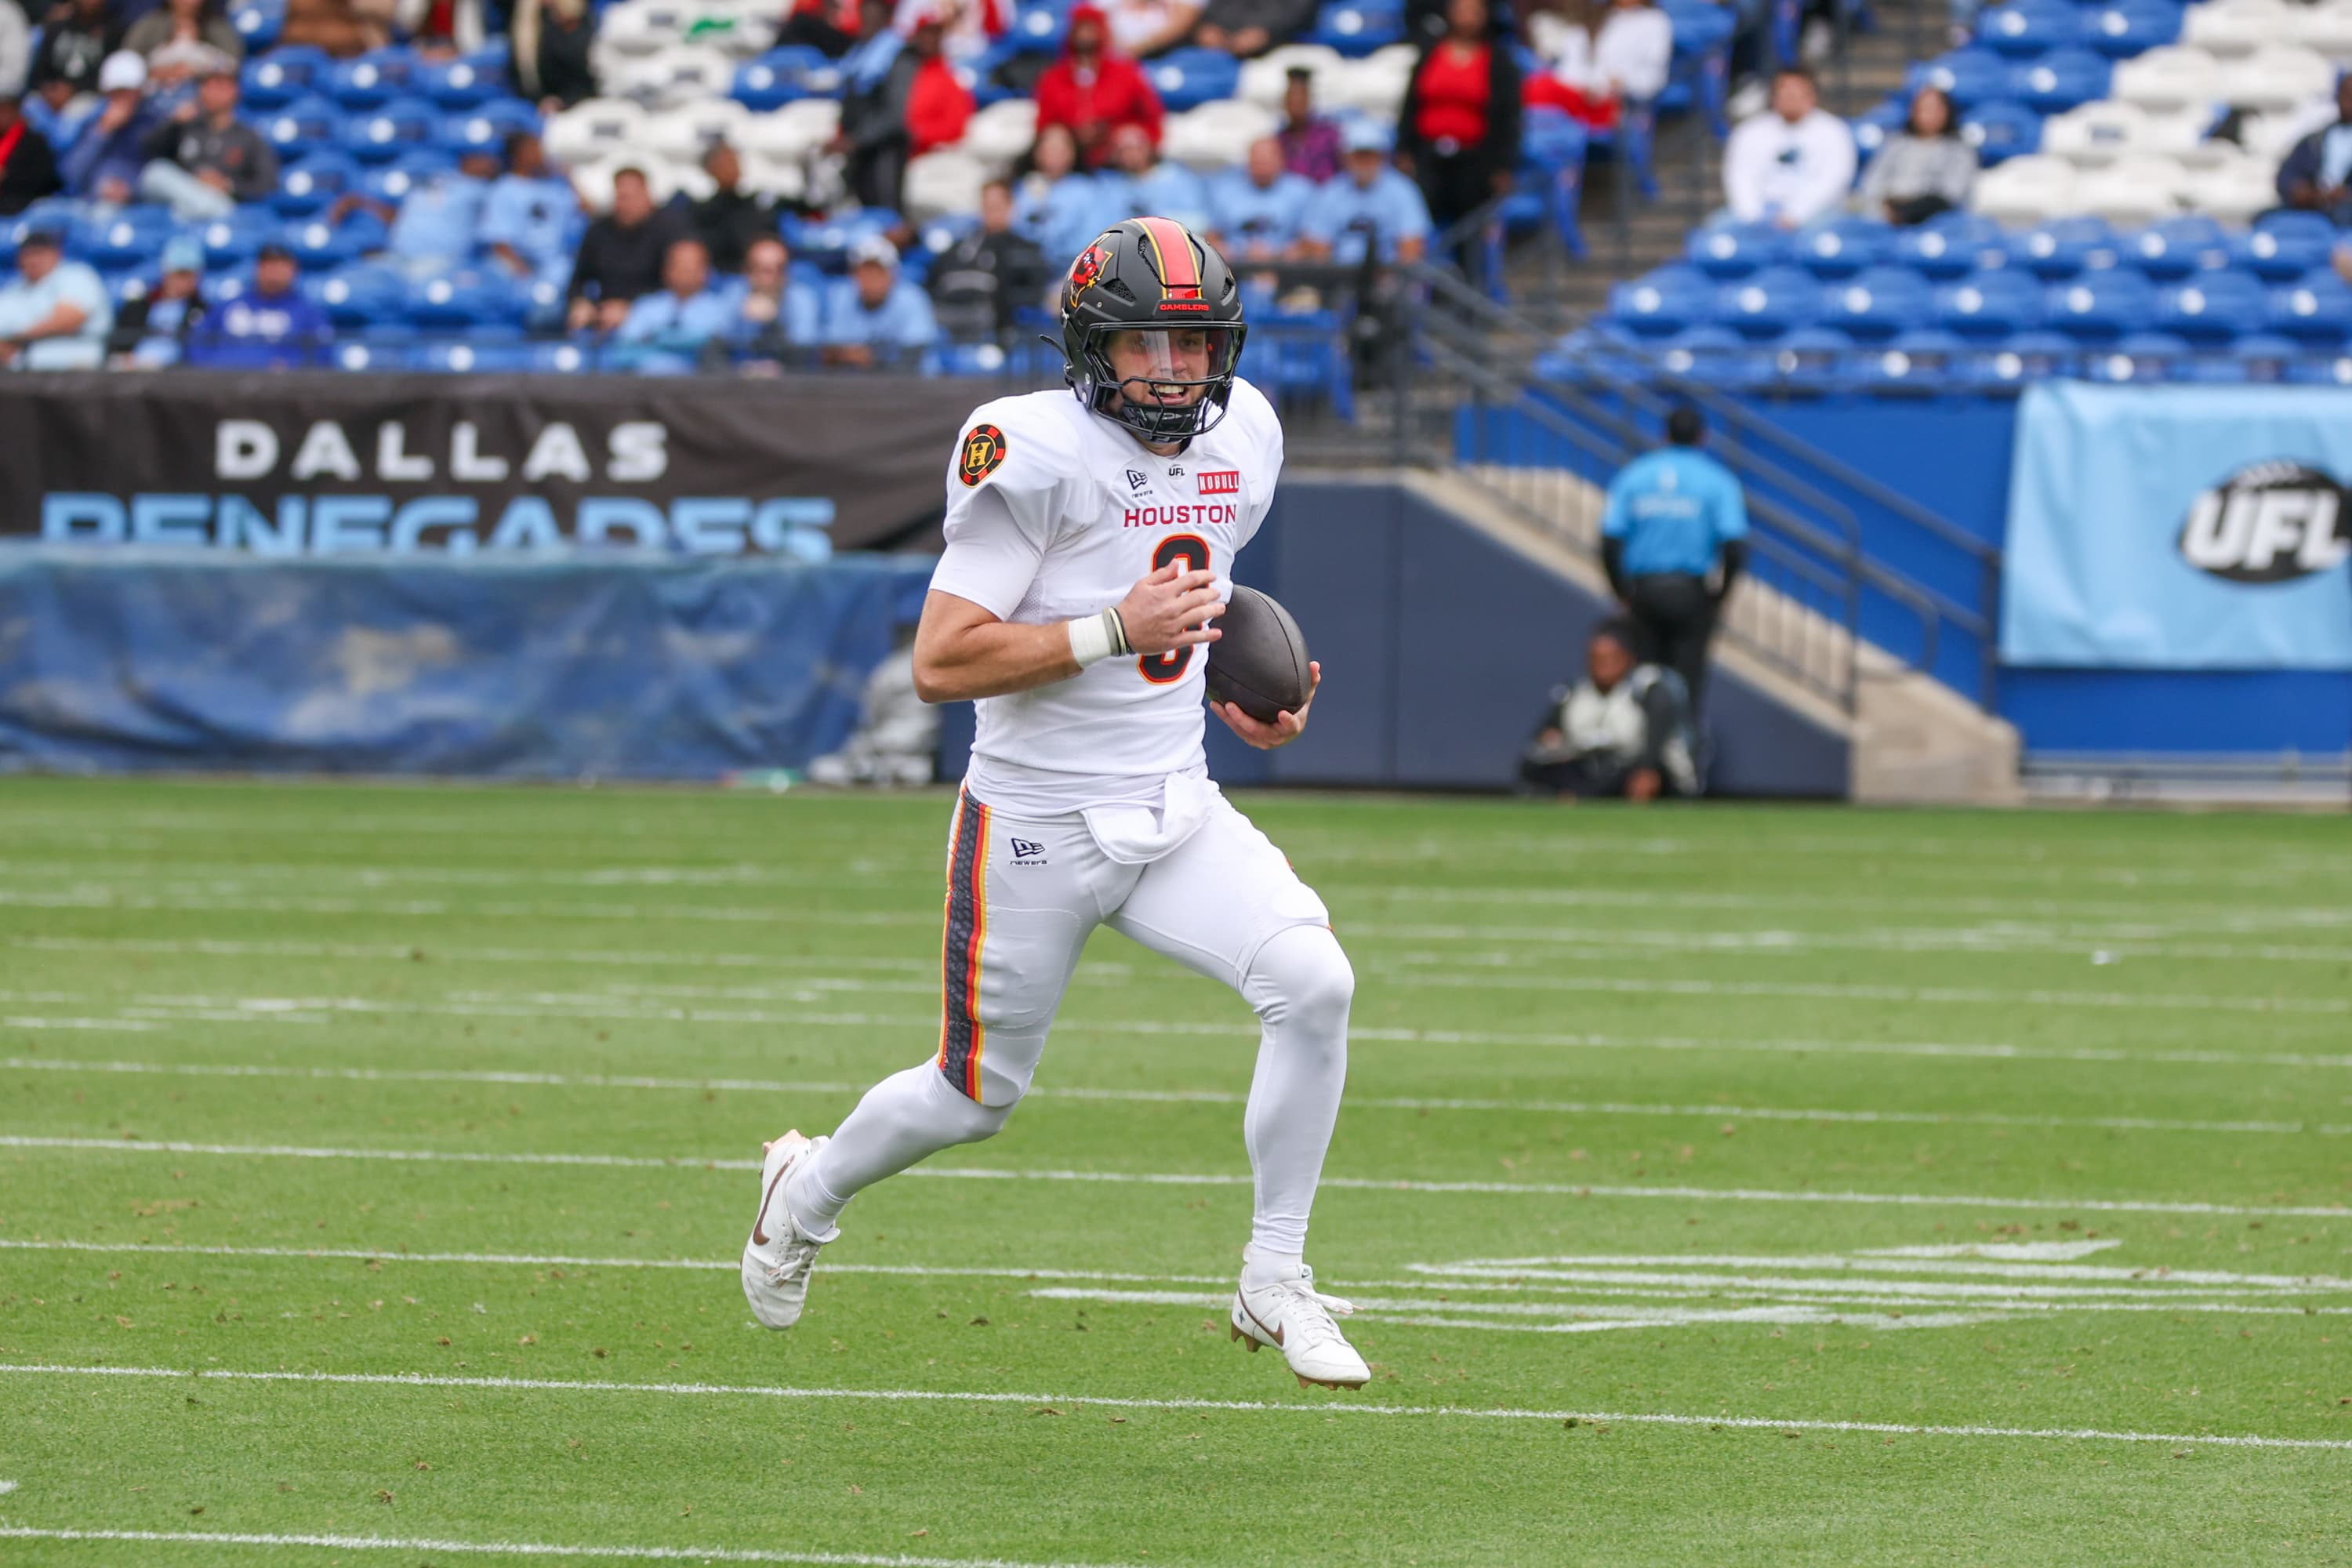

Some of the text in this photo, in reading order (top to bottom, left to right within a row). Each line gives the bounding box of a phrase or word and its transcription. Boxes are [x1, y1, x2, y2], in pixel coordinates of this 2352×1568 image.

[1160, 303, 1210, 312] GAMBLERS
[215, 419, 669, 482] DALLAS
[1168, 467, 1185, 477] UFL
[1199, 473, 1239, 492] NOBULL
[42, 492, 836, 561] RENEGADES
[1123, 504, 1237, 528] HOUSTON
[2181, 487, 2351, 571] UFL
